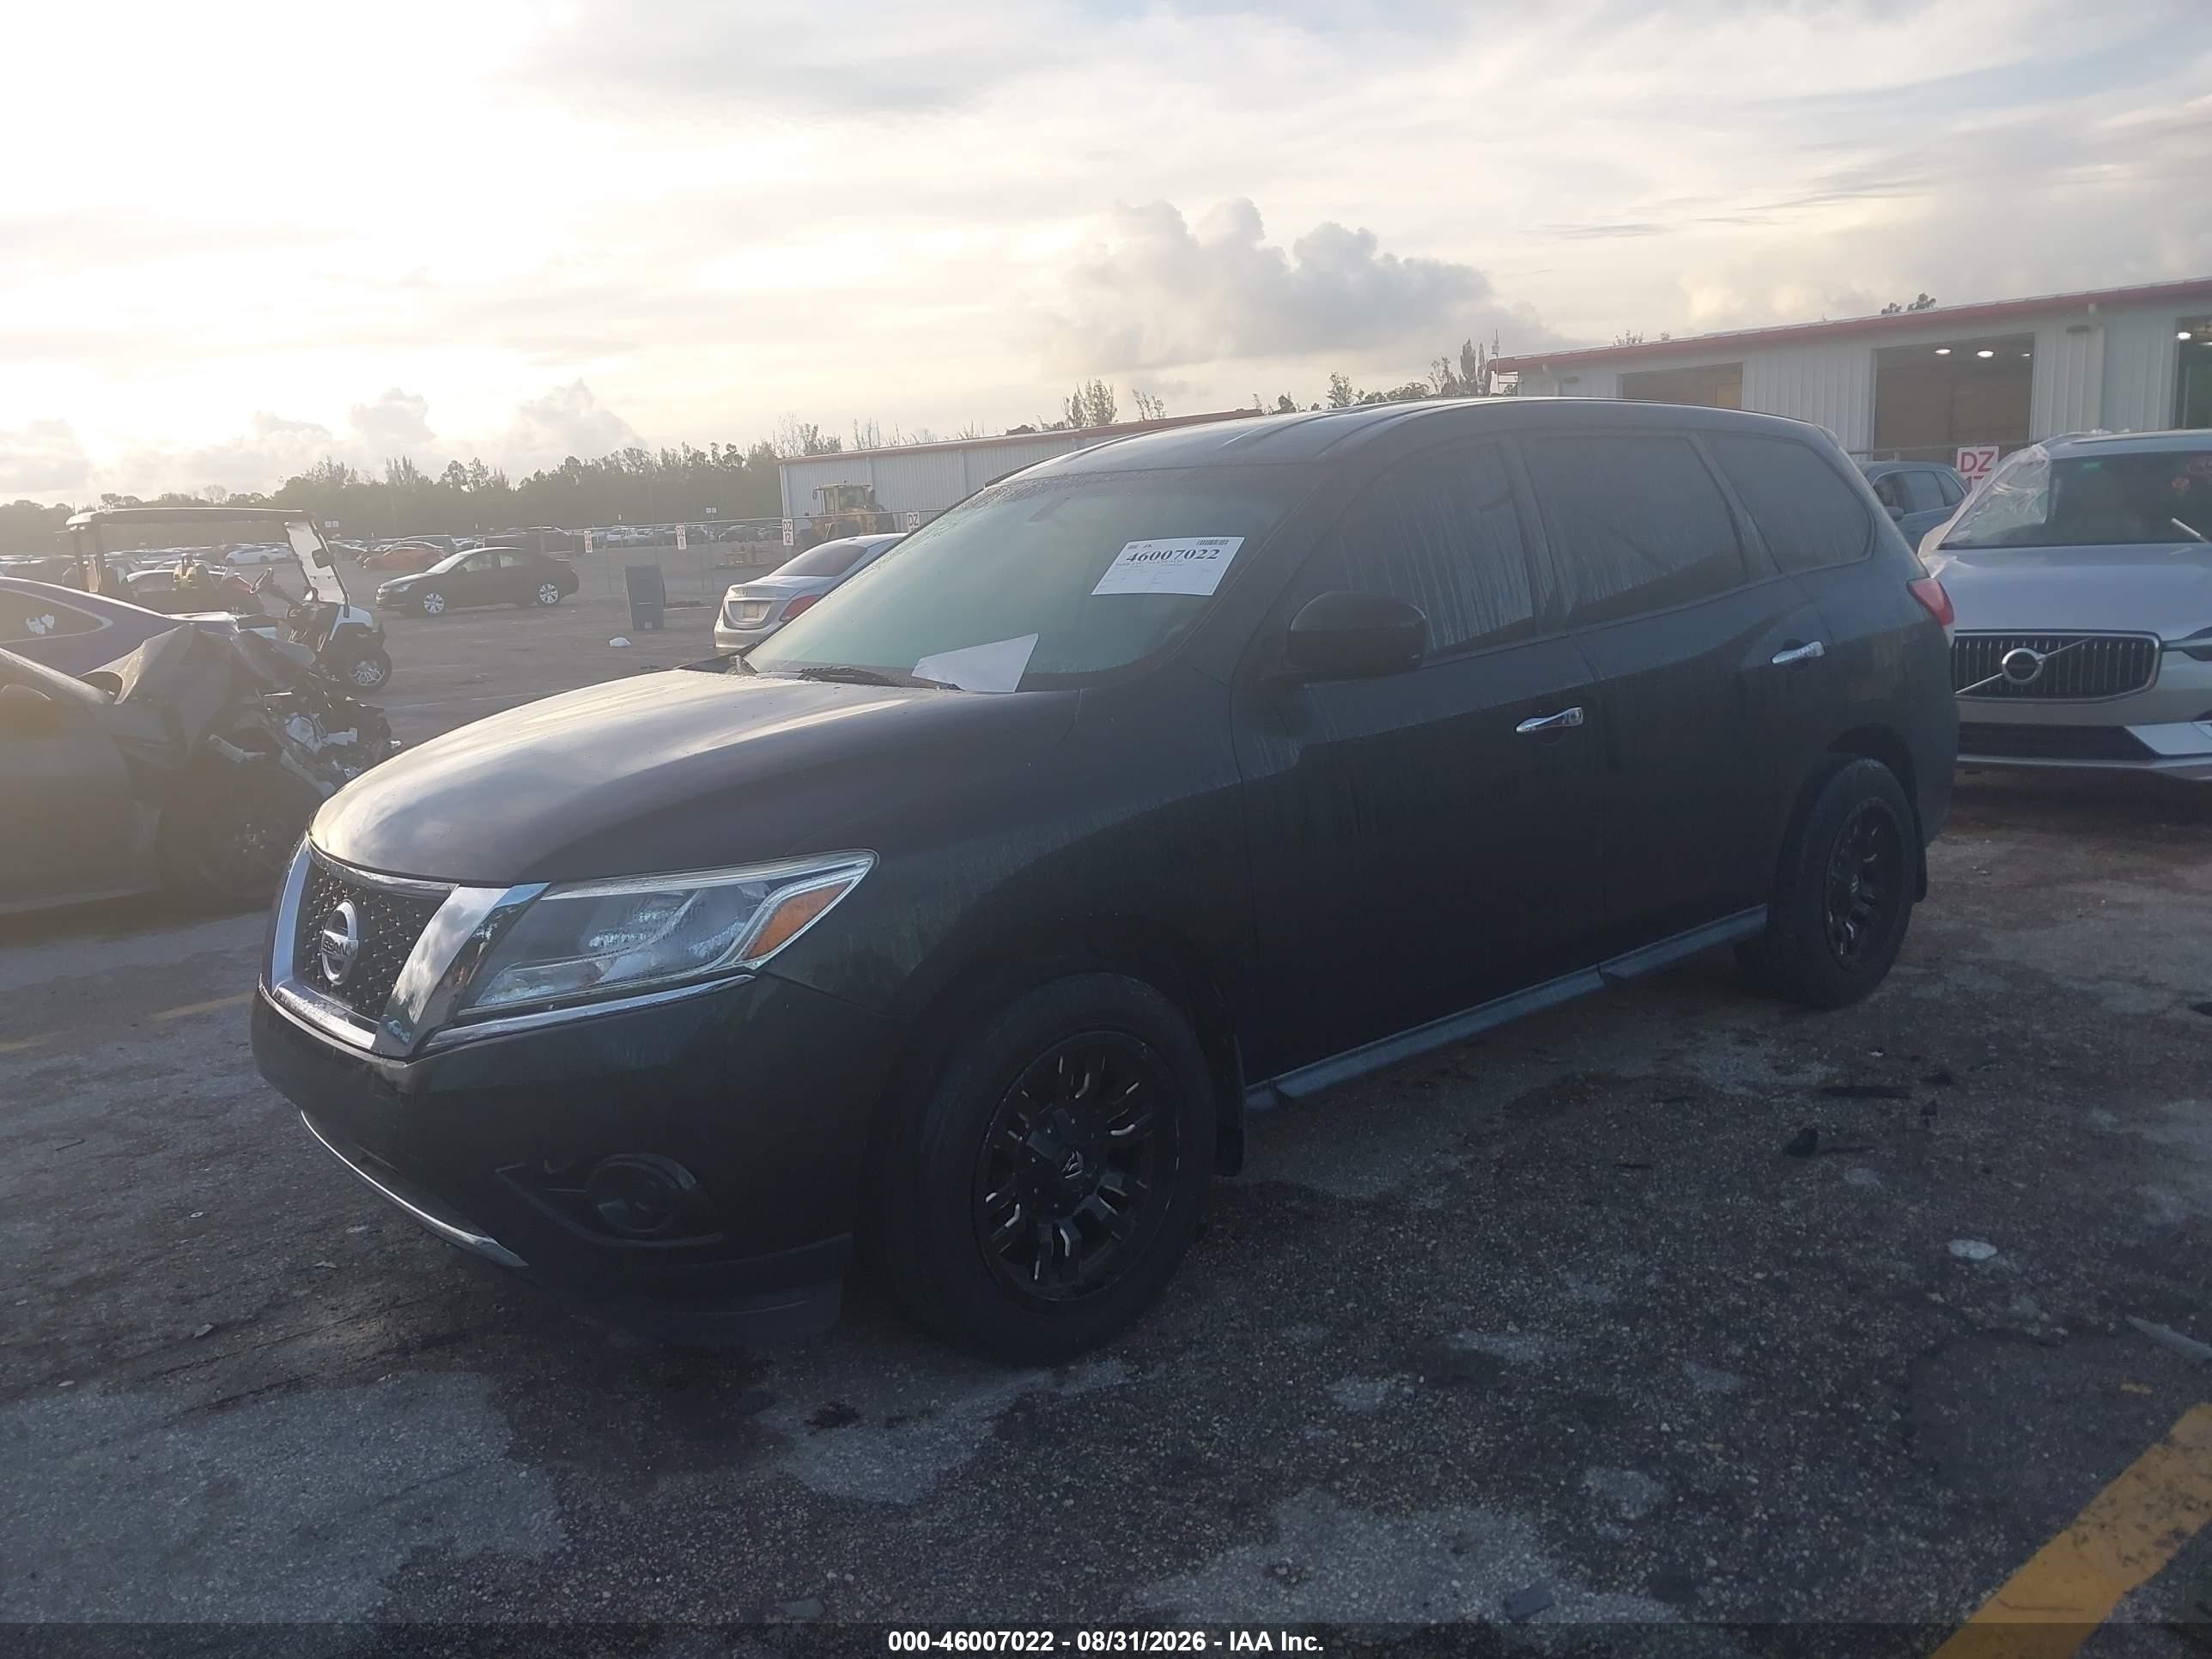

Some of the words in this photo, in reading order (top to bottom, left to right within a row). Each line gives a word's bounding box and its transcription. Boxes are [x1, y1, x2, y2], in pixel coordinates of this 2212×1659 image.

[1960, 451, 1994, 473] DZ
[1966, 475, 1984, 489] 1
[783, 520, 792, 532] DZ
[908, 514, 919, 526] DZ
[1127, 549, 1220, 562] 46007022
